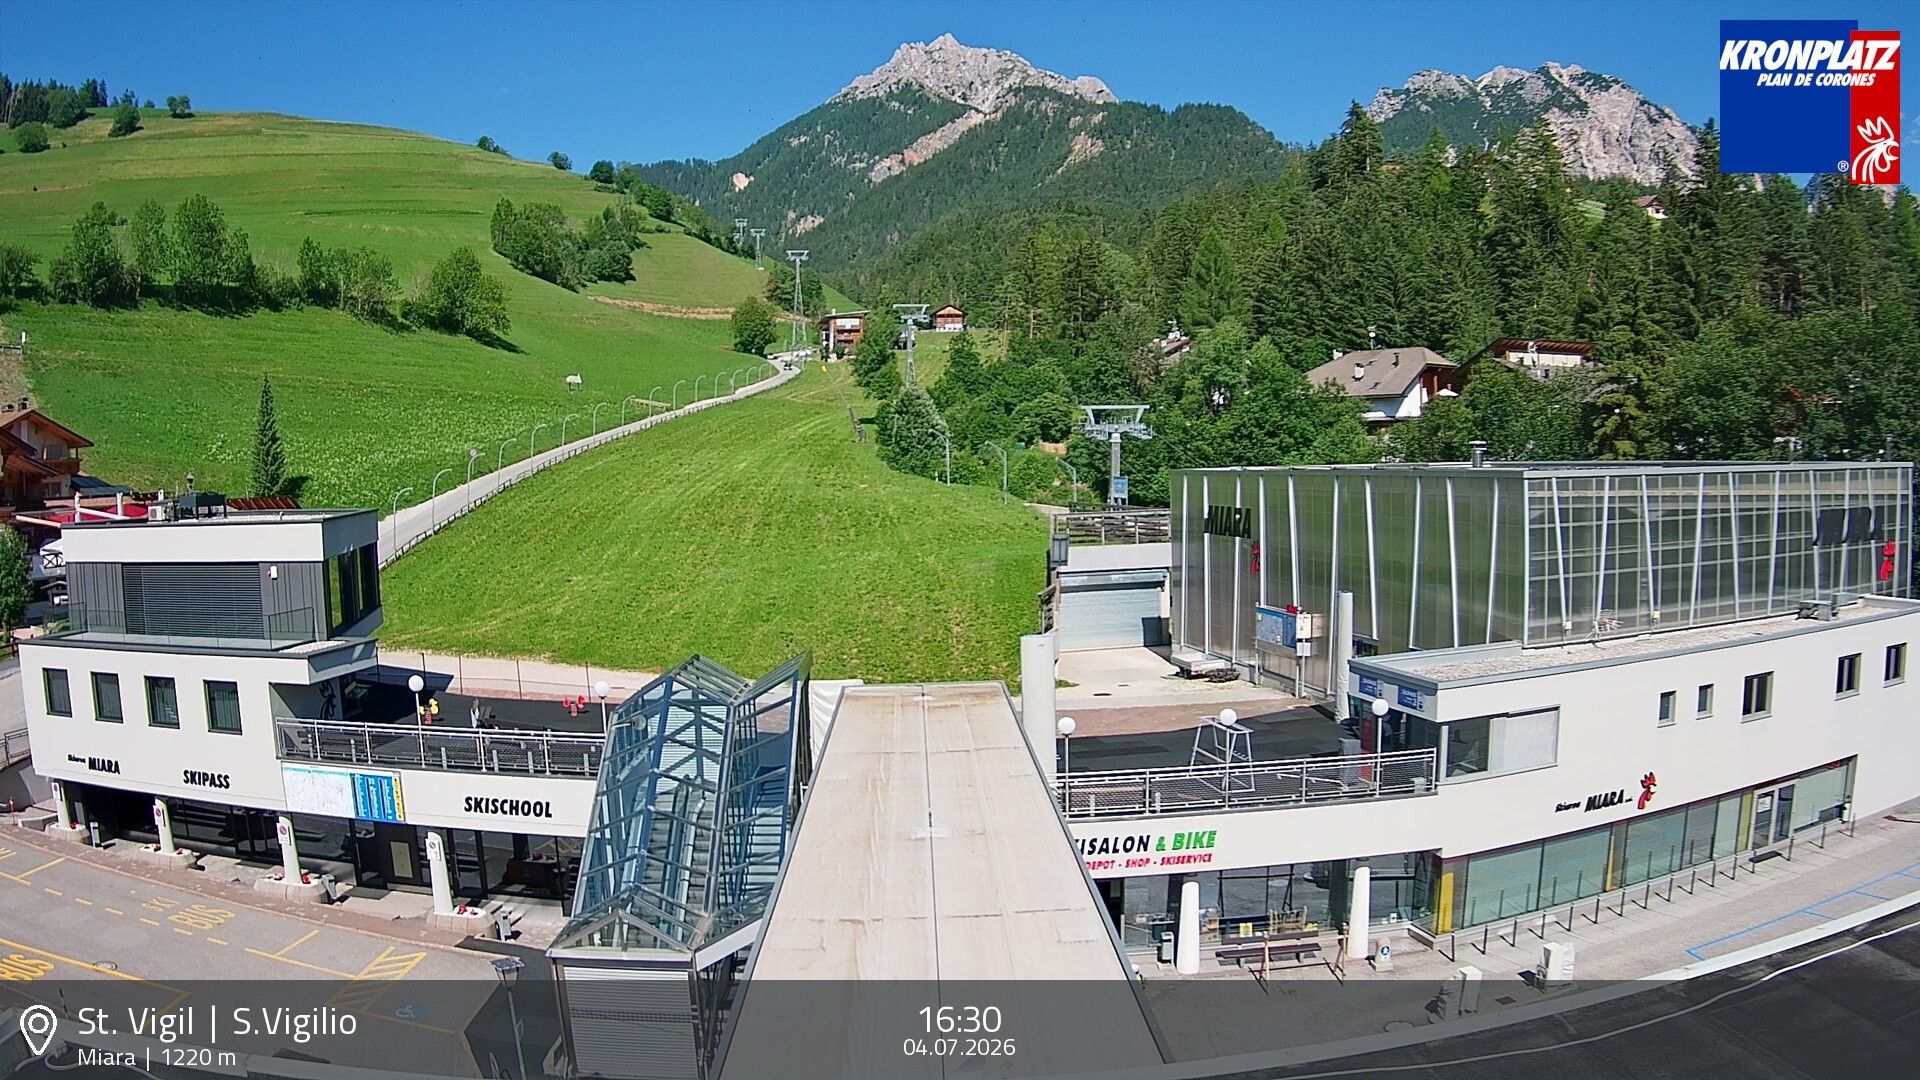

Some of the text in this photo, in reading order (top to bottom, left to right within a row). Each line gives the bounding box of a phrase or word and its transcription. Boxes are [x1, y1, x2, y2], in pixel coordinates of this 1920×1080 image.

[1203, 505, 1251, 539] MIARA
[88, 757, 121, 775] MIARA
[183, 769, 230, 789] SKIPASS
[464, 796, 552, 818] SKISCHOOL
[1584, 789, 1624, 812] MIARA
[1074, 830, 1217, 856] ISALON & BIKE
[1125, 857, 1150, 868] SHOP
[1160, 853, 1213, 866] SKISERVICE
[167, 903, 236, 930] BUS
